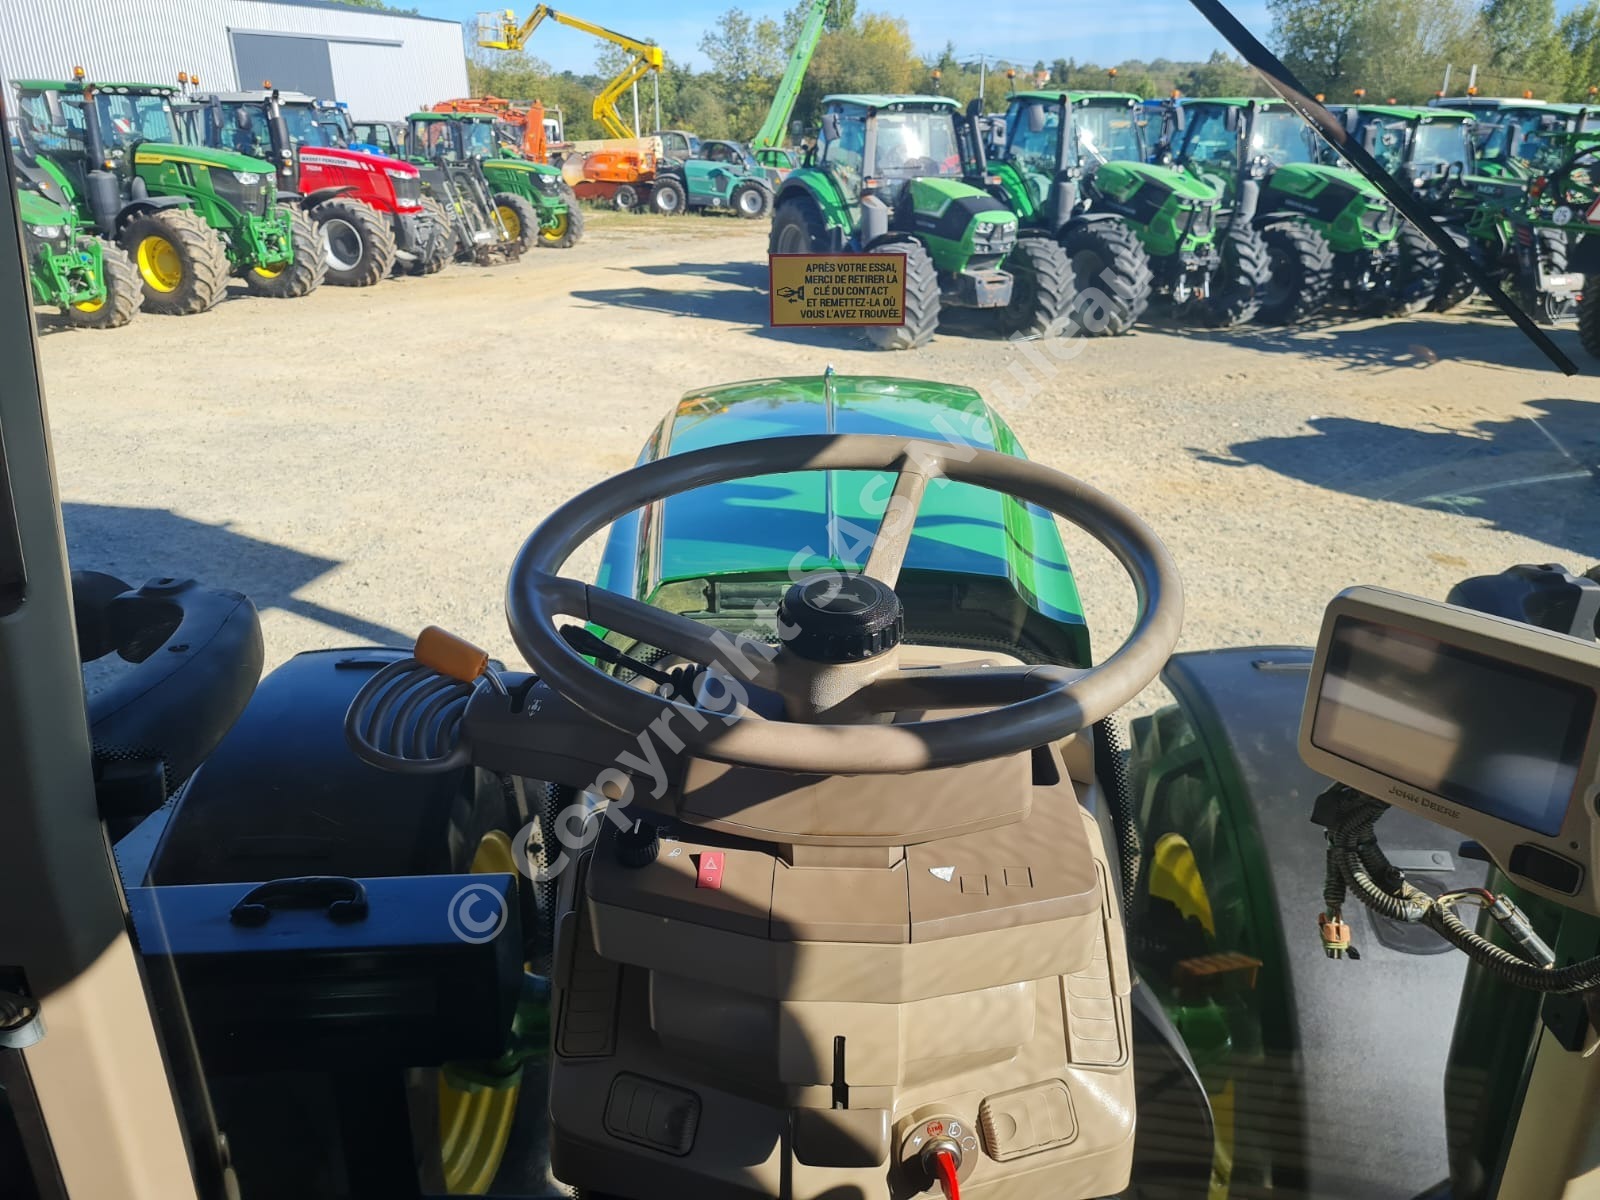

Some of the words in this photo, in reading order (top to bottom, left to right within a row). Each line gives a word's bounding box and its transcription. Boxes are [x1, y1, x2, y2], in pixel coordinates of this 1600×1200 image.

[806, 263, 835, 272] APRÈS
[837, 264, 868, 272] VOTRE
[869, 263, 897, 273] ESSAI,
[805, 275, 833, 284] MERCI
[834, 275, 847, 284] DE
[848, 275, 886, 284] RETIRER
[887, 275, 898, 284] LA
[813, 286, 830, 295] CLÉ
[832, 287, 844, 295] DU
[846, 286, 889, 295] CONTACT
[807, 299, 817, 307] ET
[820, 298, 880, 307] REMETTEZ-LA
[883, 296, 896, 307] OÙ
[800, 310, 825, 318] VOUS
[826, 310, 856, 318] L'AVEZ
[1388, 786, 1420, 803] JOHN
[1421, 797, 1461, 819] DEERE
